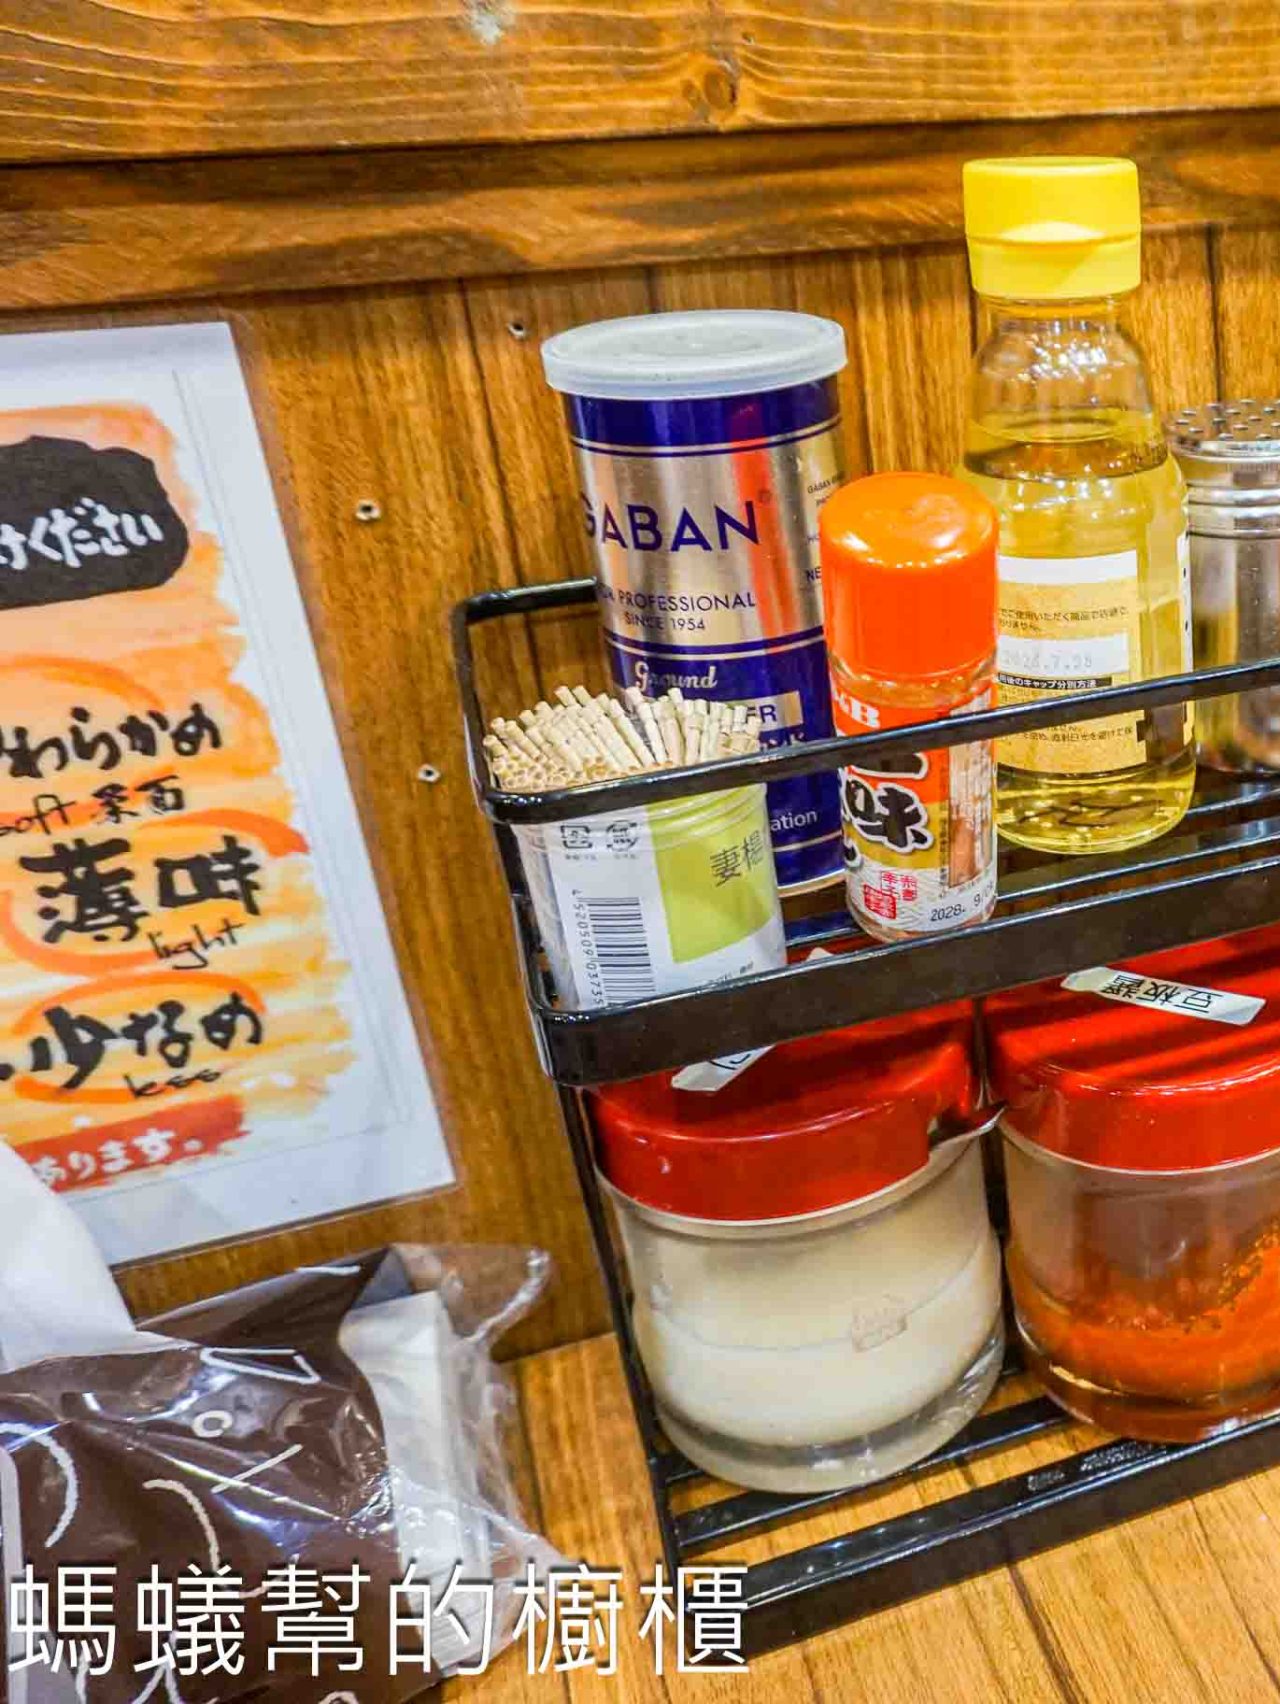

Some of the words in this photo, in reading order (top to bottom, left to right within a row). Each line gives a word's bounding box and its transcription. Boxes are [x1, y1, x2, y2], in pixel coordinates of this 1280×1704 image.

[617, 591, 756, 612] PROFESSIONAL
[624, 610, 664, 630] SINCE
[671, 616, 705, 631] 1954
[635, 660, 719, 690] Ground
[0, 703, 222, 778] わらかめ
[19, 835, 261, 943] 薄味
[147, 918, 245, 970] light
